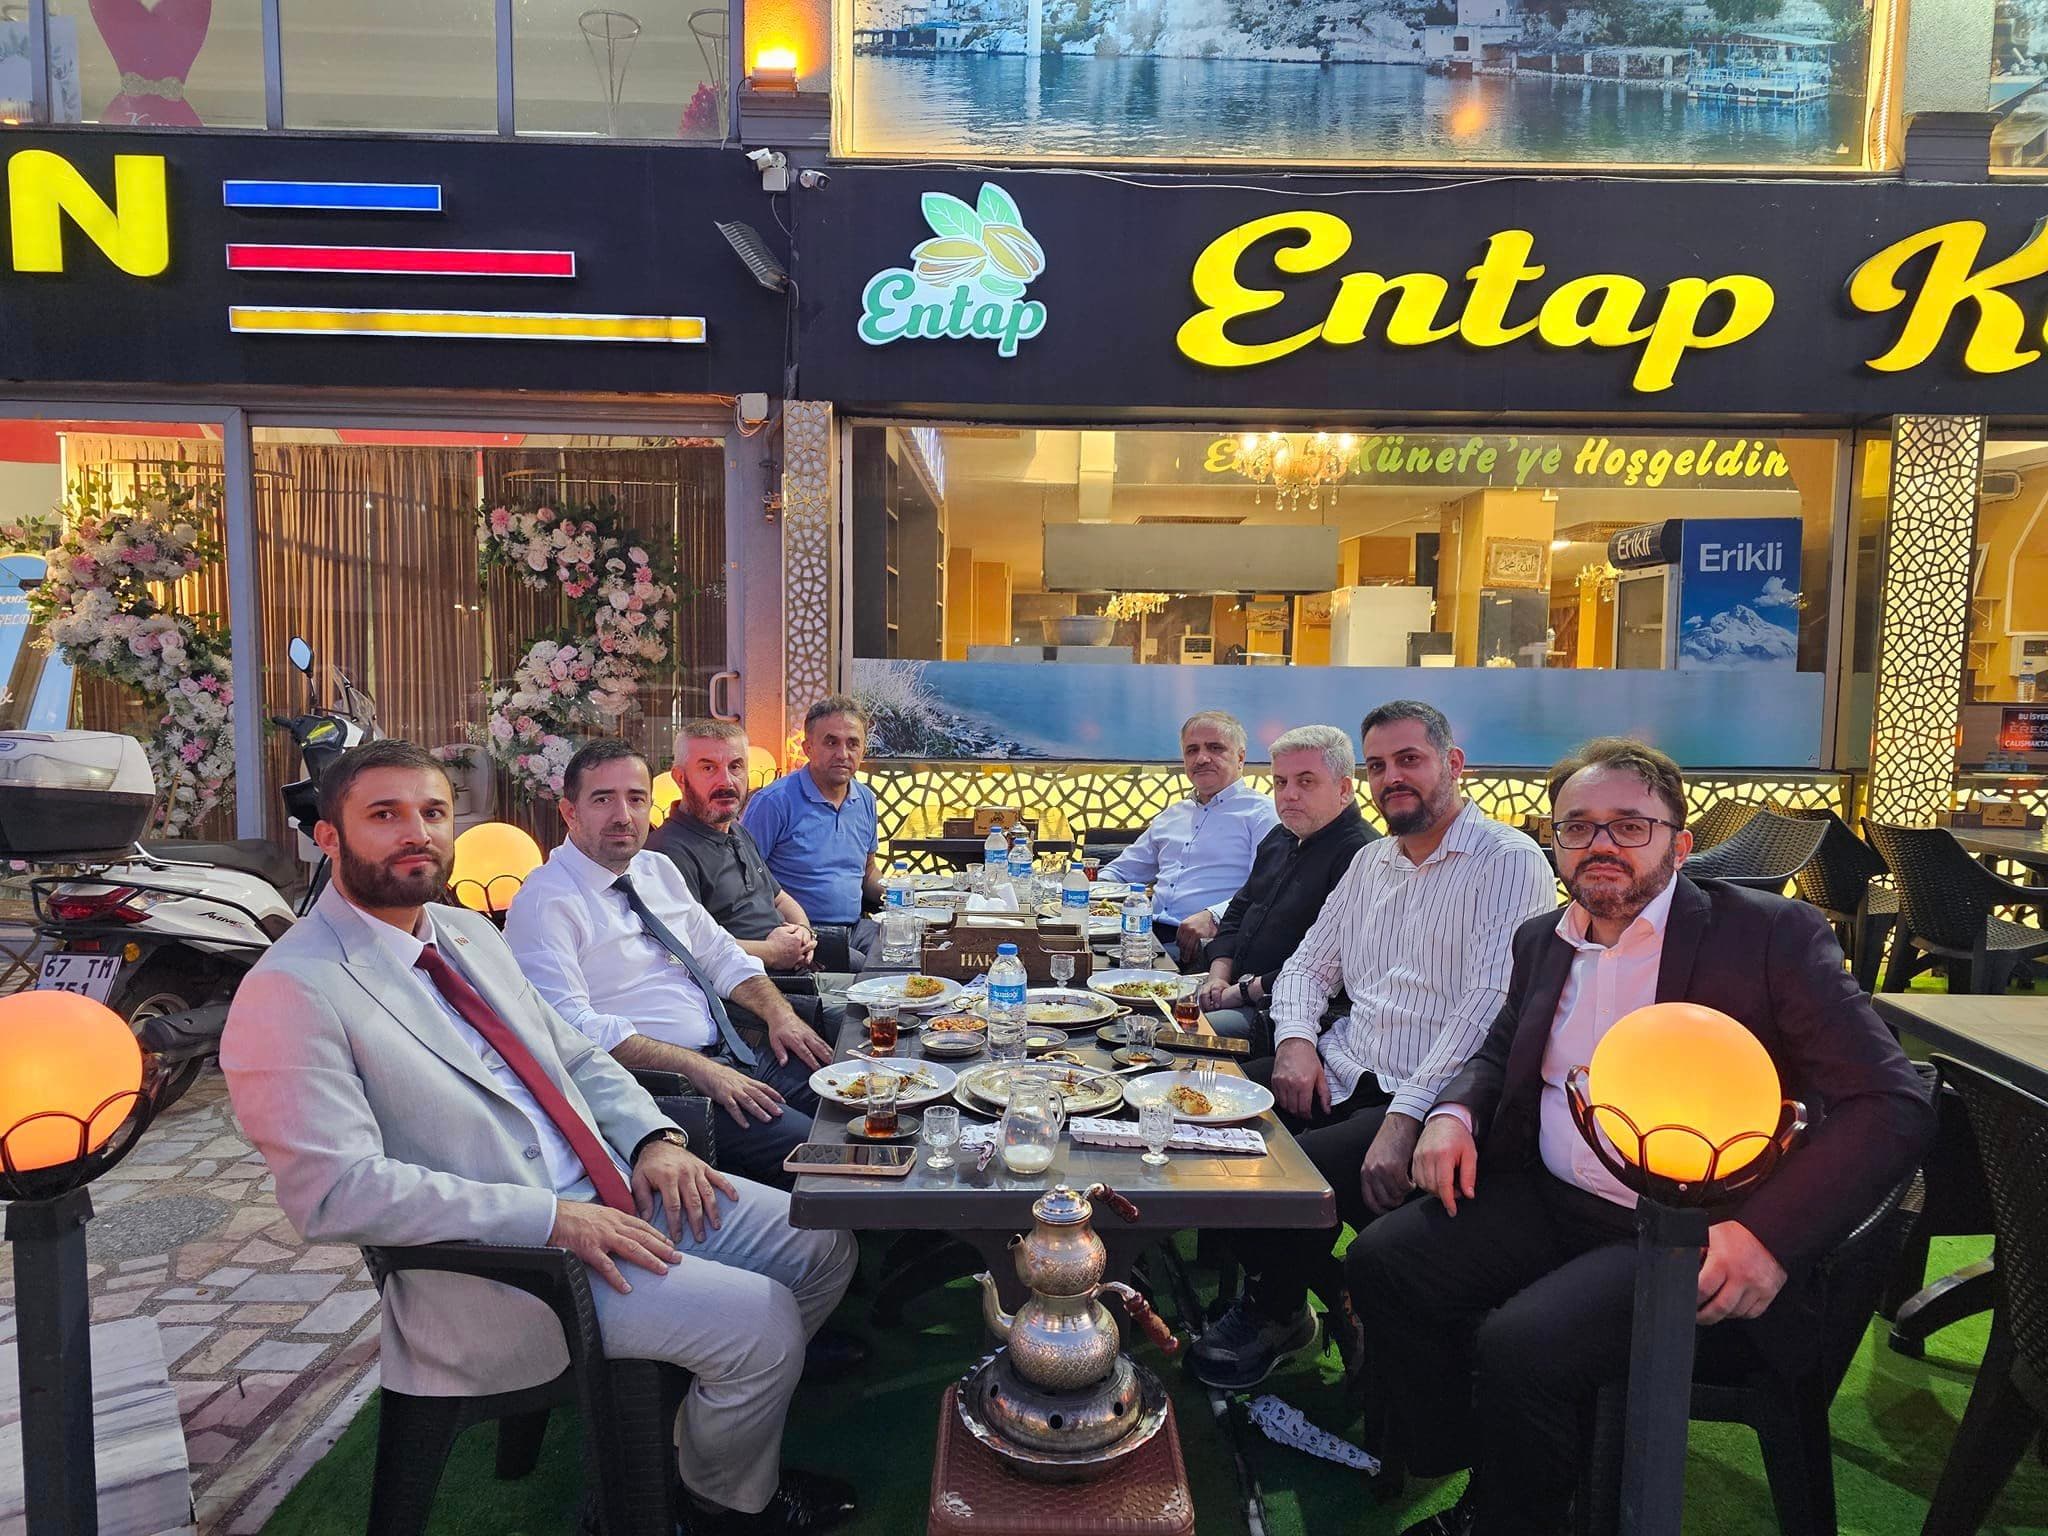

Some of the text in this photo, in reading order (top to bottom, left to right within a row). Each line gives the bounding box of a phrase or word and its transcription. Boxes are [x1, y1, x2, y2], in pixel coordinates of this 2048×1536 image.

[7, 149, 169, 277] N
[862, 273, 1044, 353] Entap
[1177, 210, 2048, 393] Entap K
[1573, 437, 1789, 488] Hoşgeldin
[1617, 529, 1652, 560] Erikli
[1700, 542, 1783, 572] Erikli
[45, 958, 114, 979] 67 TM
[961, 953, 993, 967] HAK
